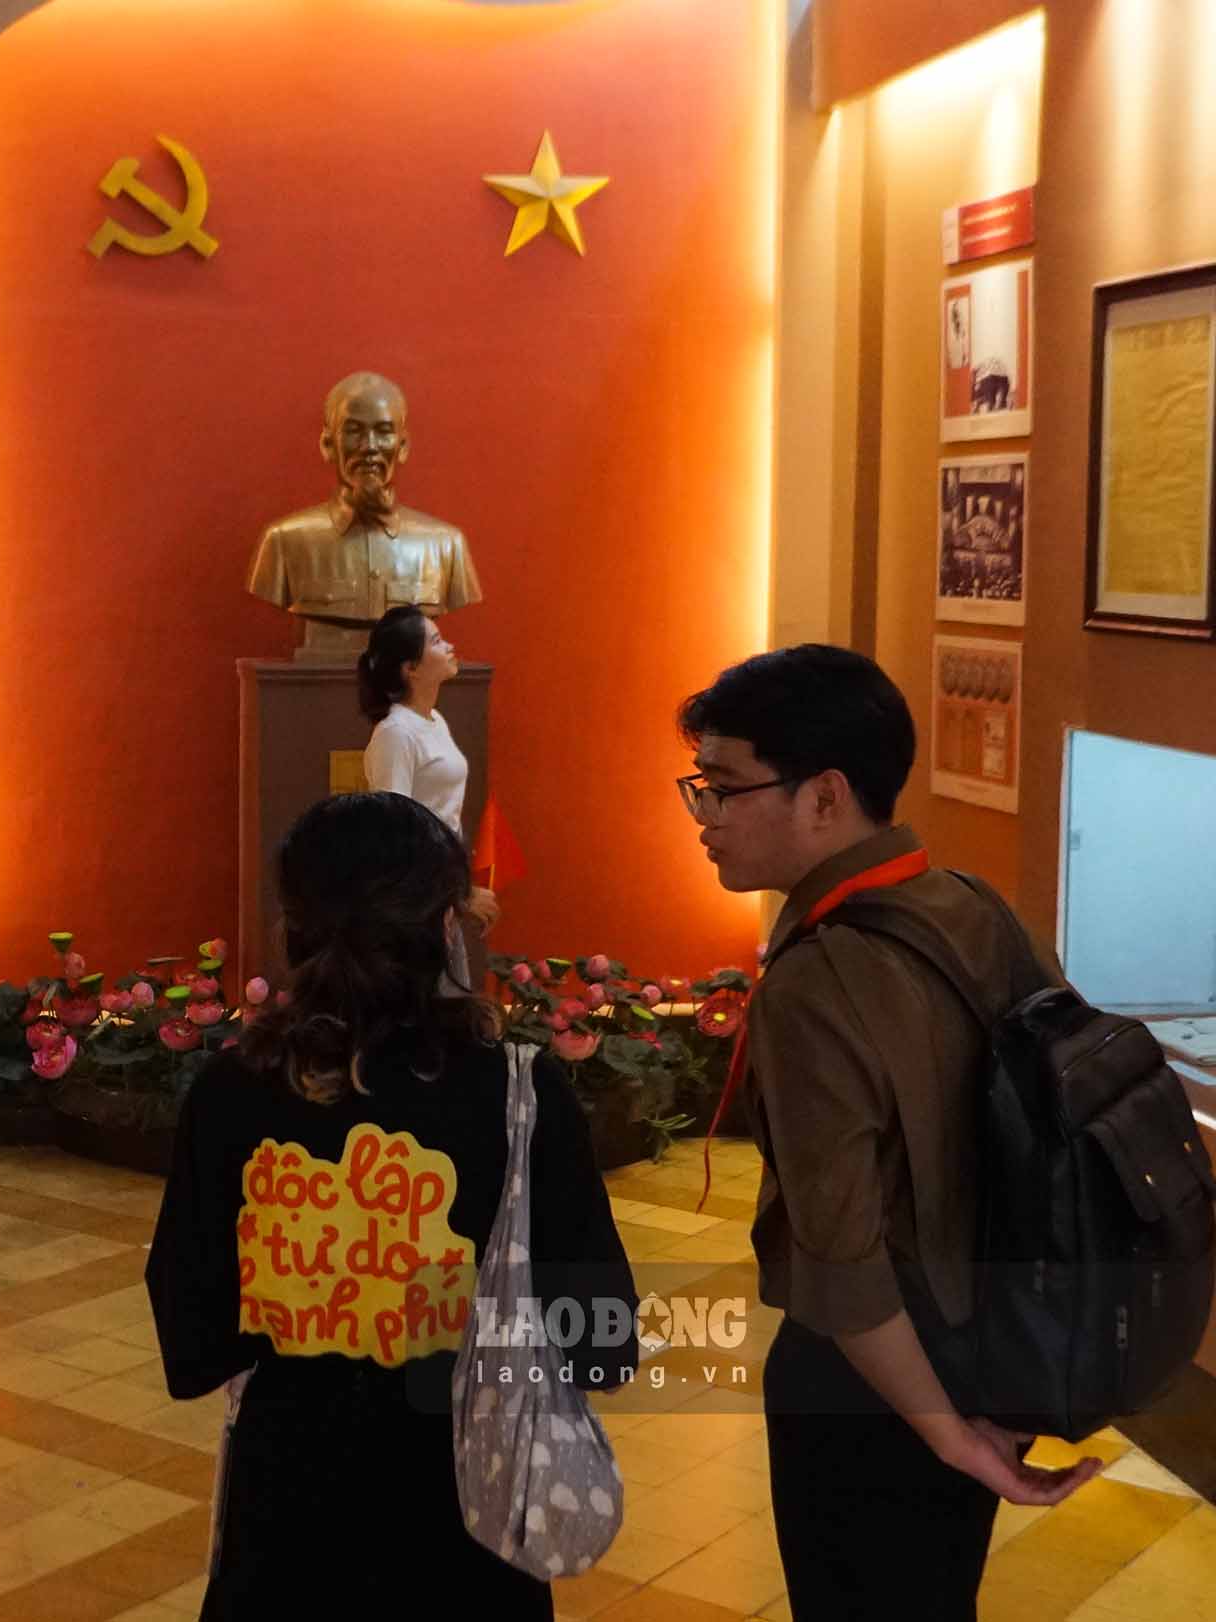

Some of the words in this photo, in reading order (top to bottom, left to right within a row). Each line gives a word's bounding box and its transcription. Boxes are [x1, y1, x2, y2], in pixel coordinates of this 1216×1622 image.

[249, 1146, 339, 1222] độc
[346, 1134, 445, 1242] lập
[262, 1222, 340, 1289] tự
[346, 1217, 431, 1282] do
[375, 1272, 470, 1361] phú
